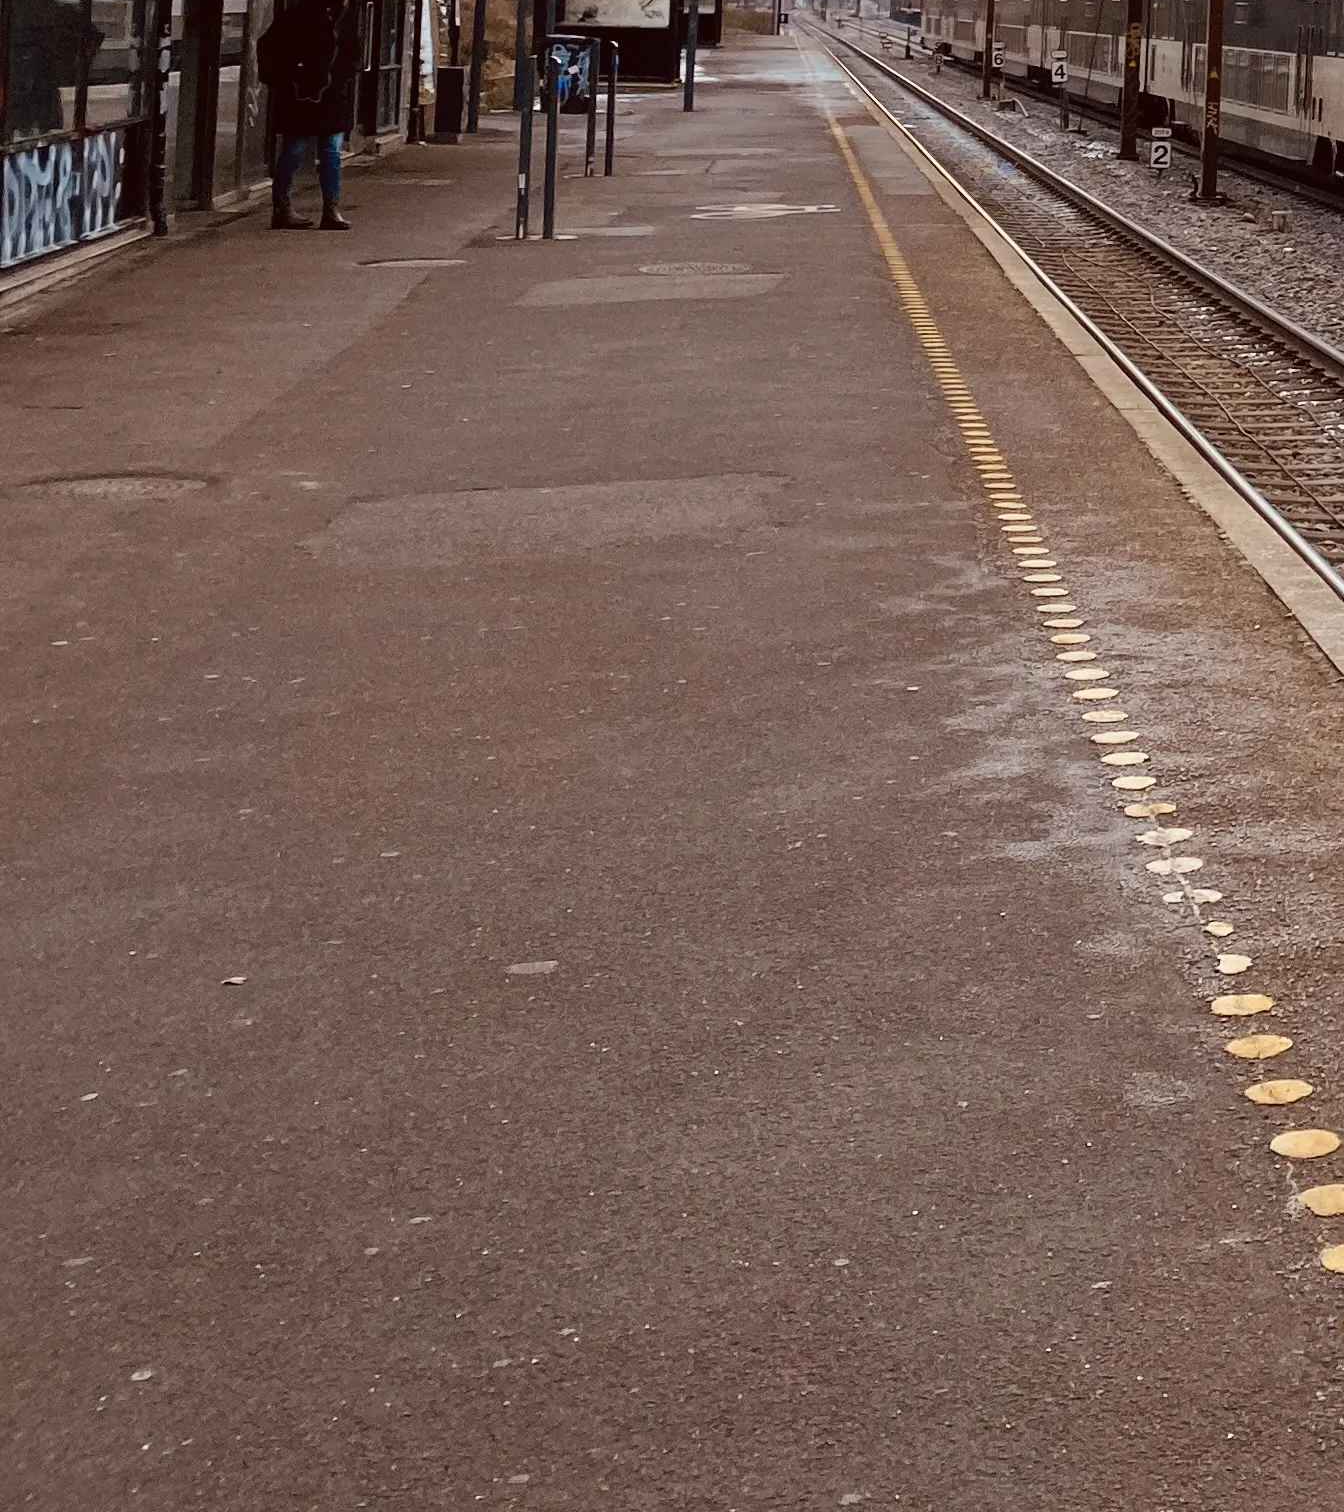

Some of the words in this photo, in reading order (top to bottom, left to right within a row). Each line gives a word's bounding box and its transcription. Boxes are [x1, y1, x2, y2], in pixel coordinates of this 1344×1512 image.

[994, 53, 1004, 66] 6
[1054, 64, 1066, 80] 4
[1153, 144, 1169, 165] 2
